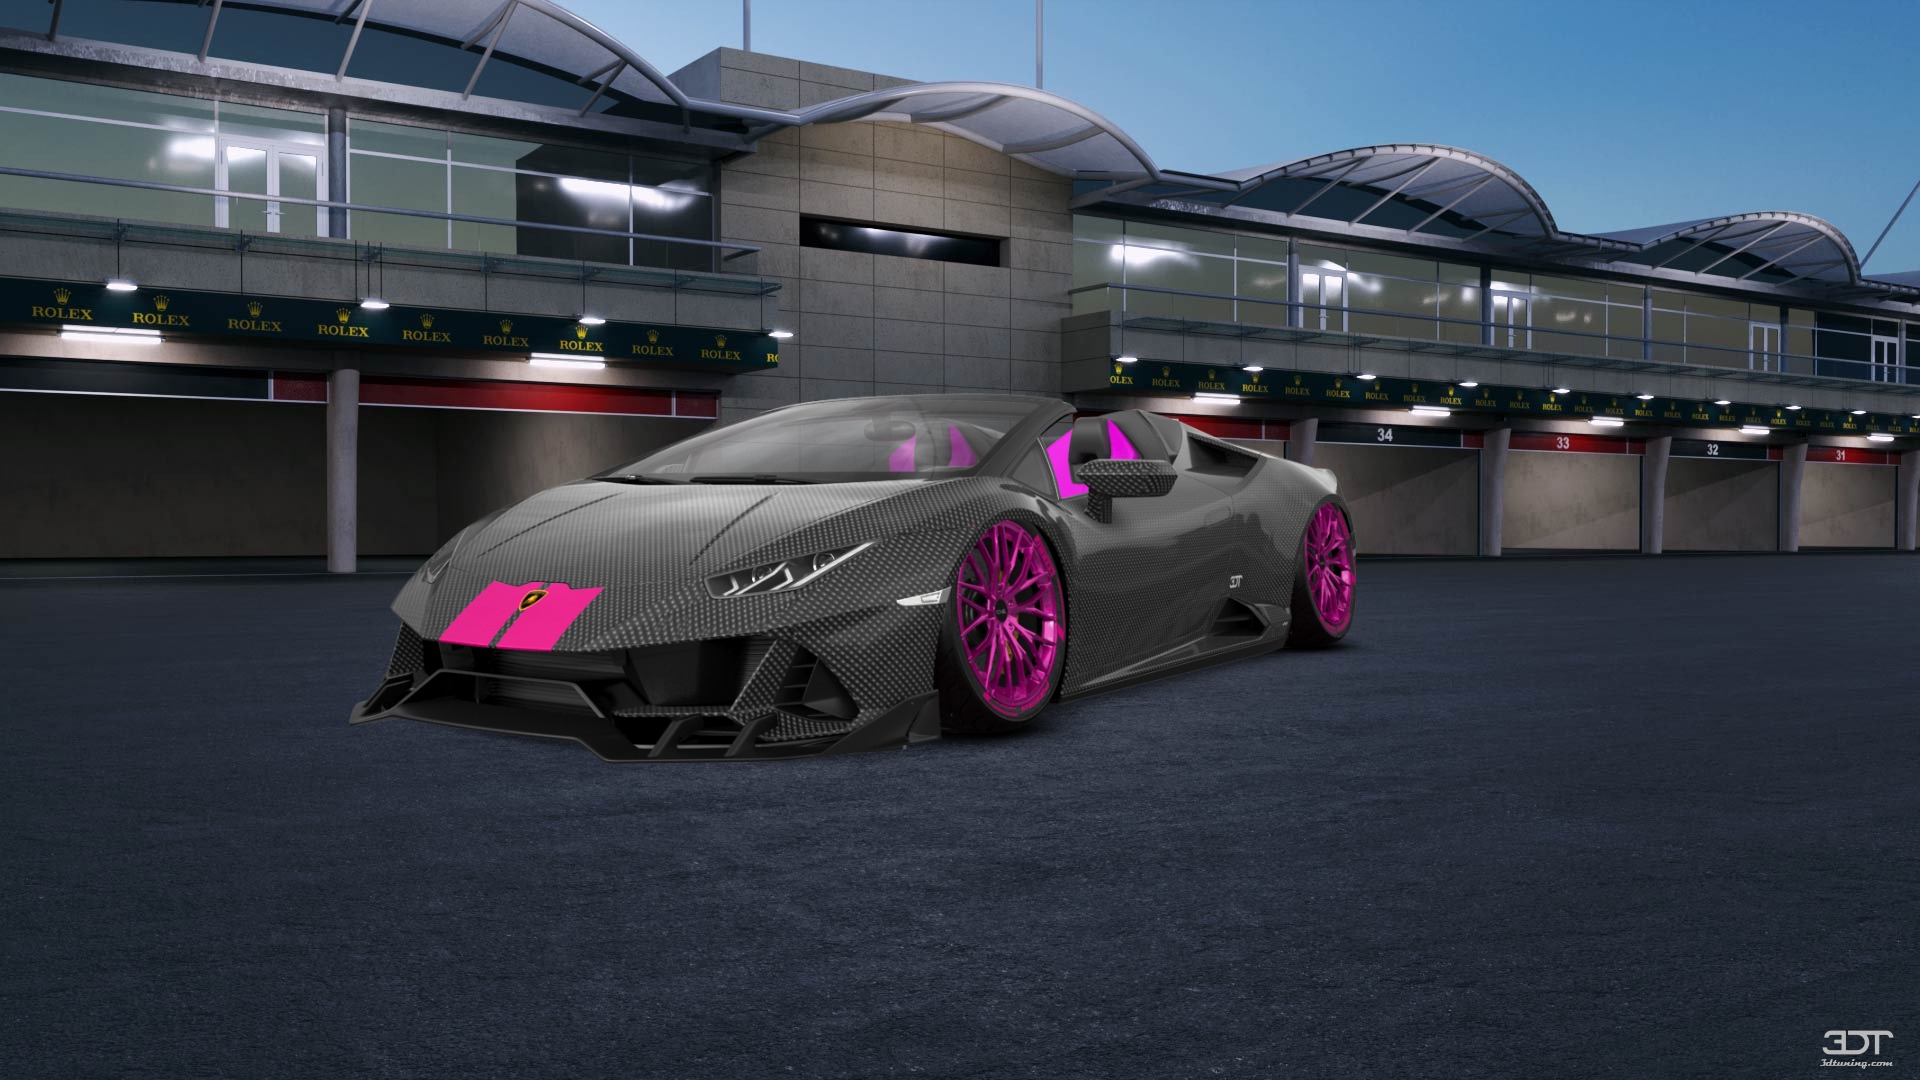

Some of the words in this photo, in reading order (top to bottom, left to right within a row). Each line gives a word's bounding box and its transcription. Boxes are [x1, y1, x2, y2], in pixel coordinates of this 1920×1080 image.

[32, 306, 94, 321] ROLEX
[133, 312, 190, 326] ROLEX
[228, 319, 282, 332] ROLEX
[318, 325, 370, 338] ROLEX
[402, 330, 451, 343] ROLEX
[483, 335, 529, 348] ROLEX
[560, 340, 603, 352] ROLEX
[632, 345, 674, 357] ROLEX
[701, 349, 742, 361] ROLEX
[1152, 378, 1181, 388] ROLEX
[1198, 381, 1225, 391] ROLEX
[1242, 384, 1269, 393] ROLEX
[1285, 386, 1310, 396] ROLEX
[1326, 390, 1350, 398] ROLEX
[1365, 392, 1389, 401] ROLEX
[1403, 394, 1425, 403] ROLEX
[1440, 397, 1462, 405] ROLEX
[1475, 399, 1497, 407] ROLEX
[1377, 428, 1393, 442] 34
[1556, 437, 1570, 449] 33
[1707, 444, 1719, 456] 32
[1836, 450, 1846, 461] 31
